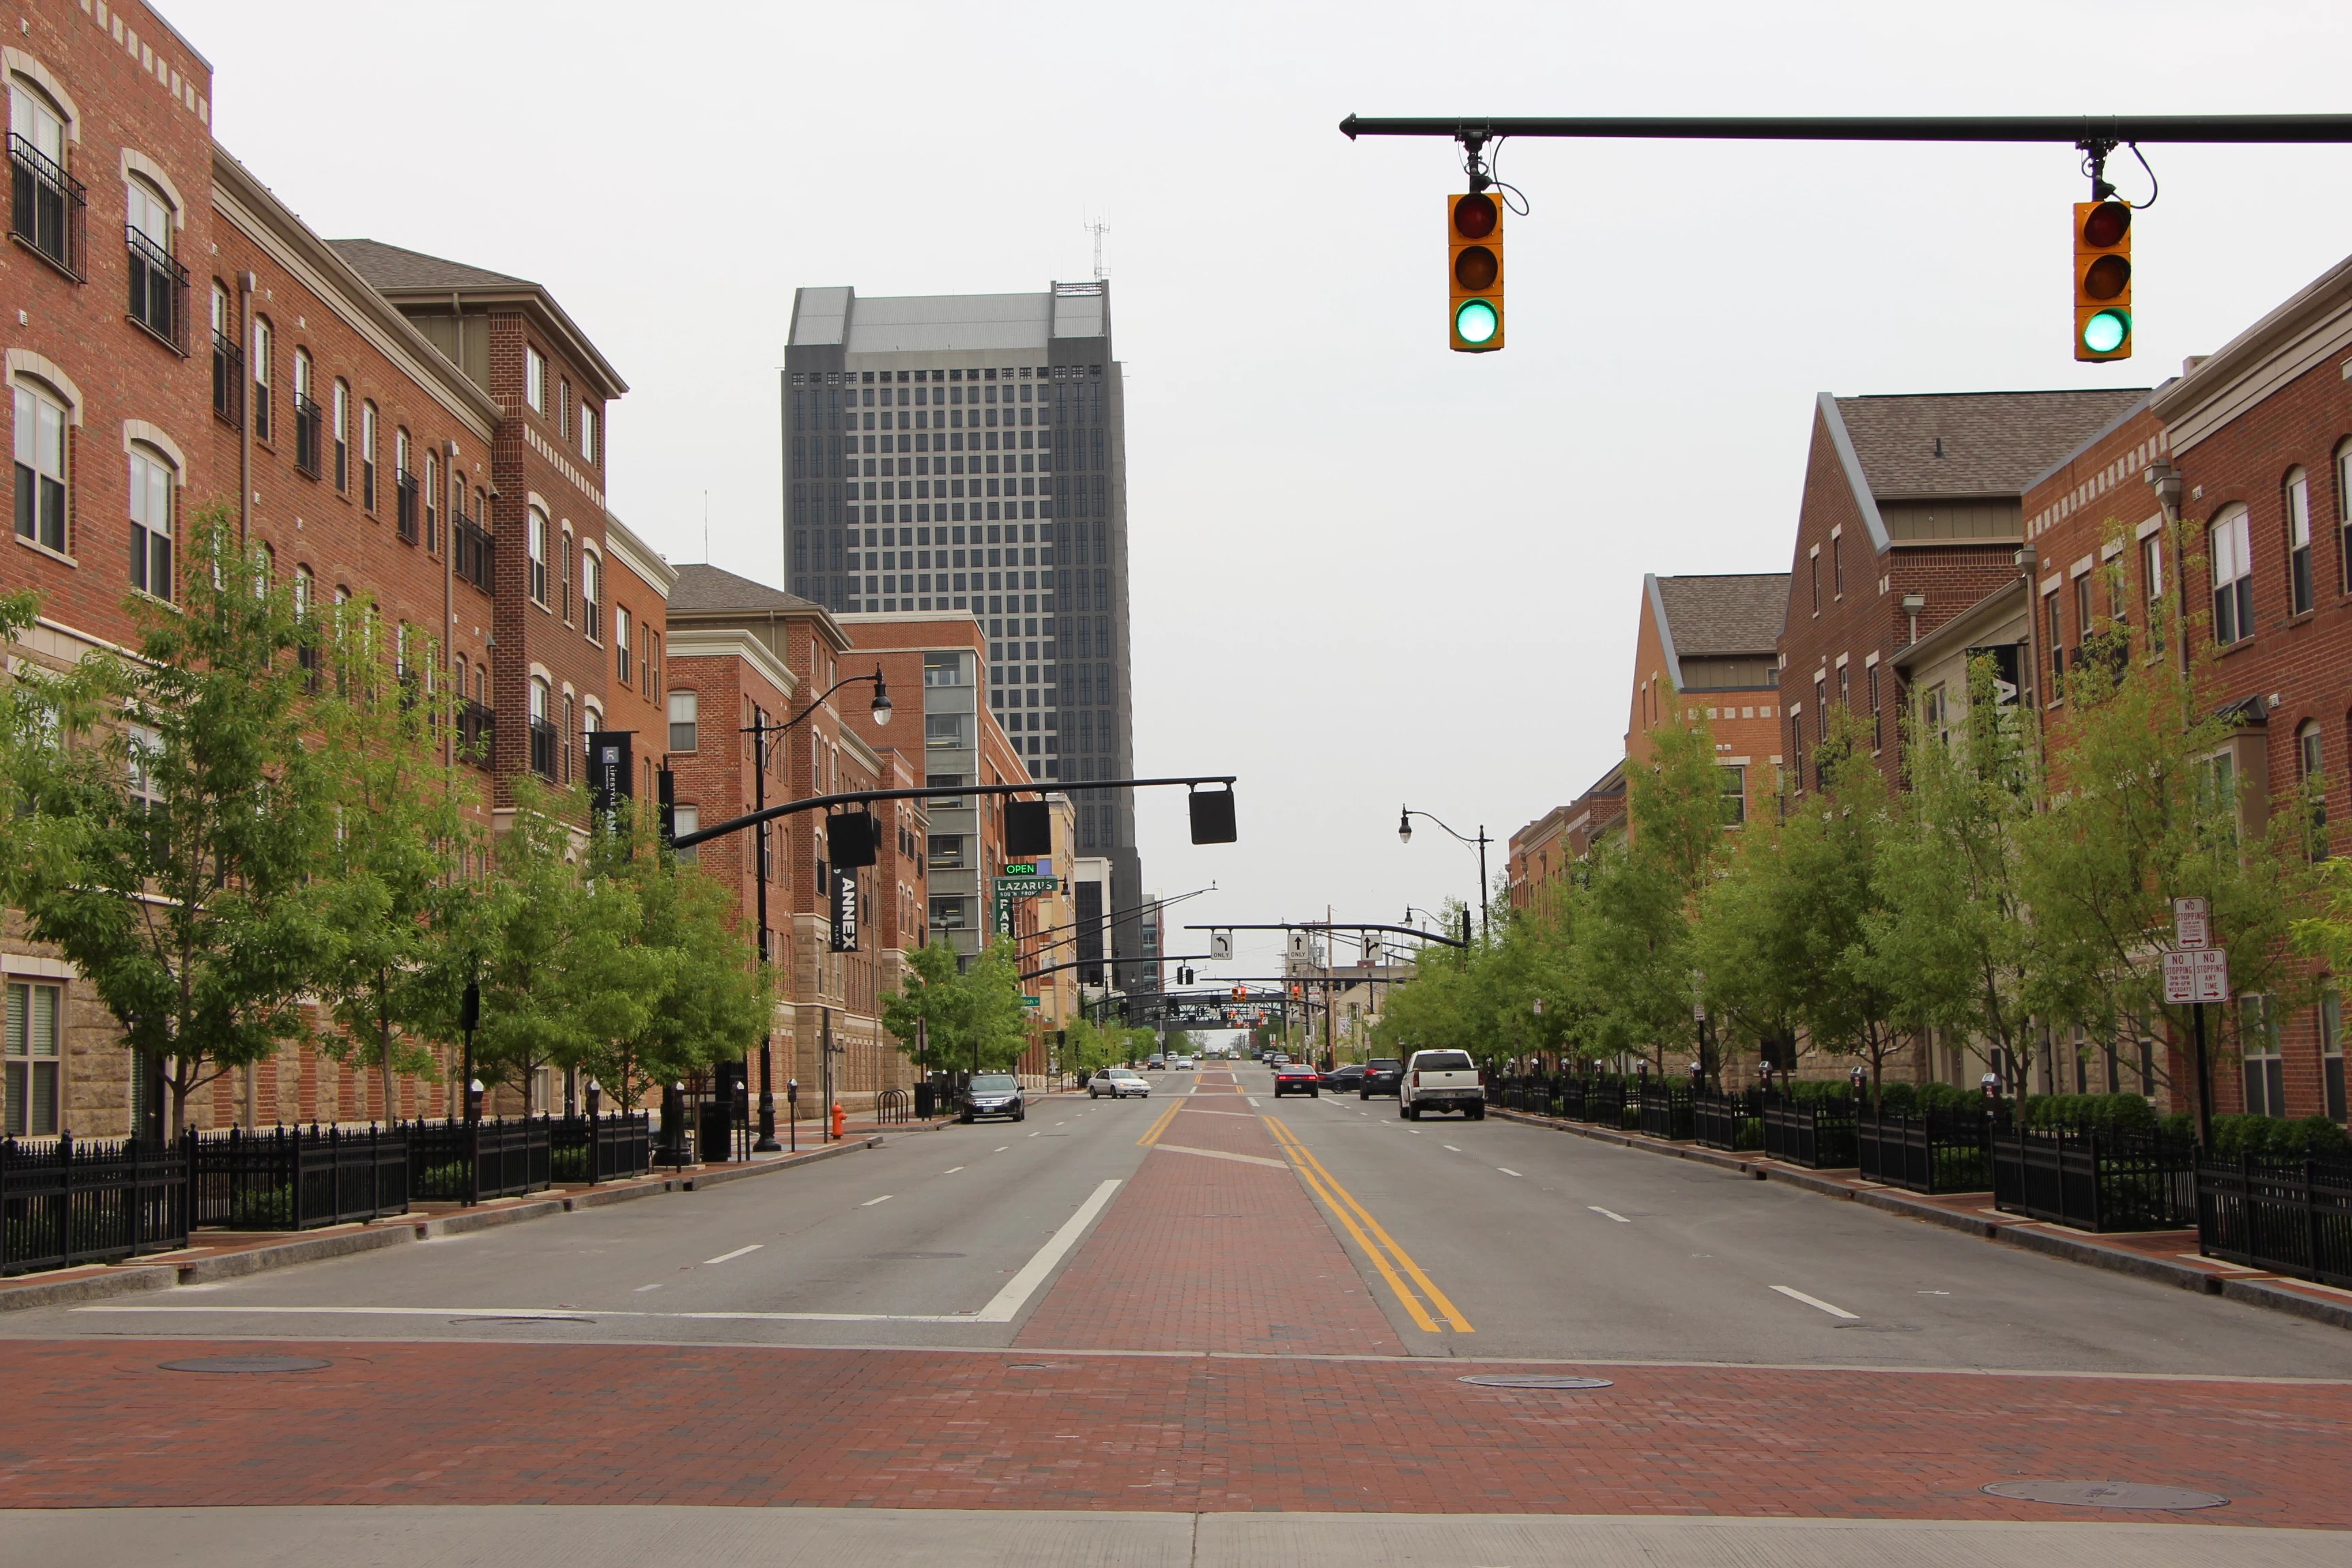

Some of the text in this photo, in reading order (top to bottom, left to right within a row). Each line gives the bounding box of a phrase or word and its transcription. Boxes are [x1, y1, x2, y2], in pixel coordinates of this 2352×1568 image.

[606, 750, 614, 760] LC
[1007, 864, 1034, 874] OPEN
[997, 881, 1052, 891] LAZARUS
[2185, 902, 2195, 911] NO
[843, 877, 855, 950] ANNEX
[2177, 912, 2205, 921] STOPPING
[2172, 955, 2183, 964] NO
[2204, 953, 2215, 963] NO
[2166, 966, 2192, 975] STOPPING
[2197, 964, 2223, 973] STOPPING
